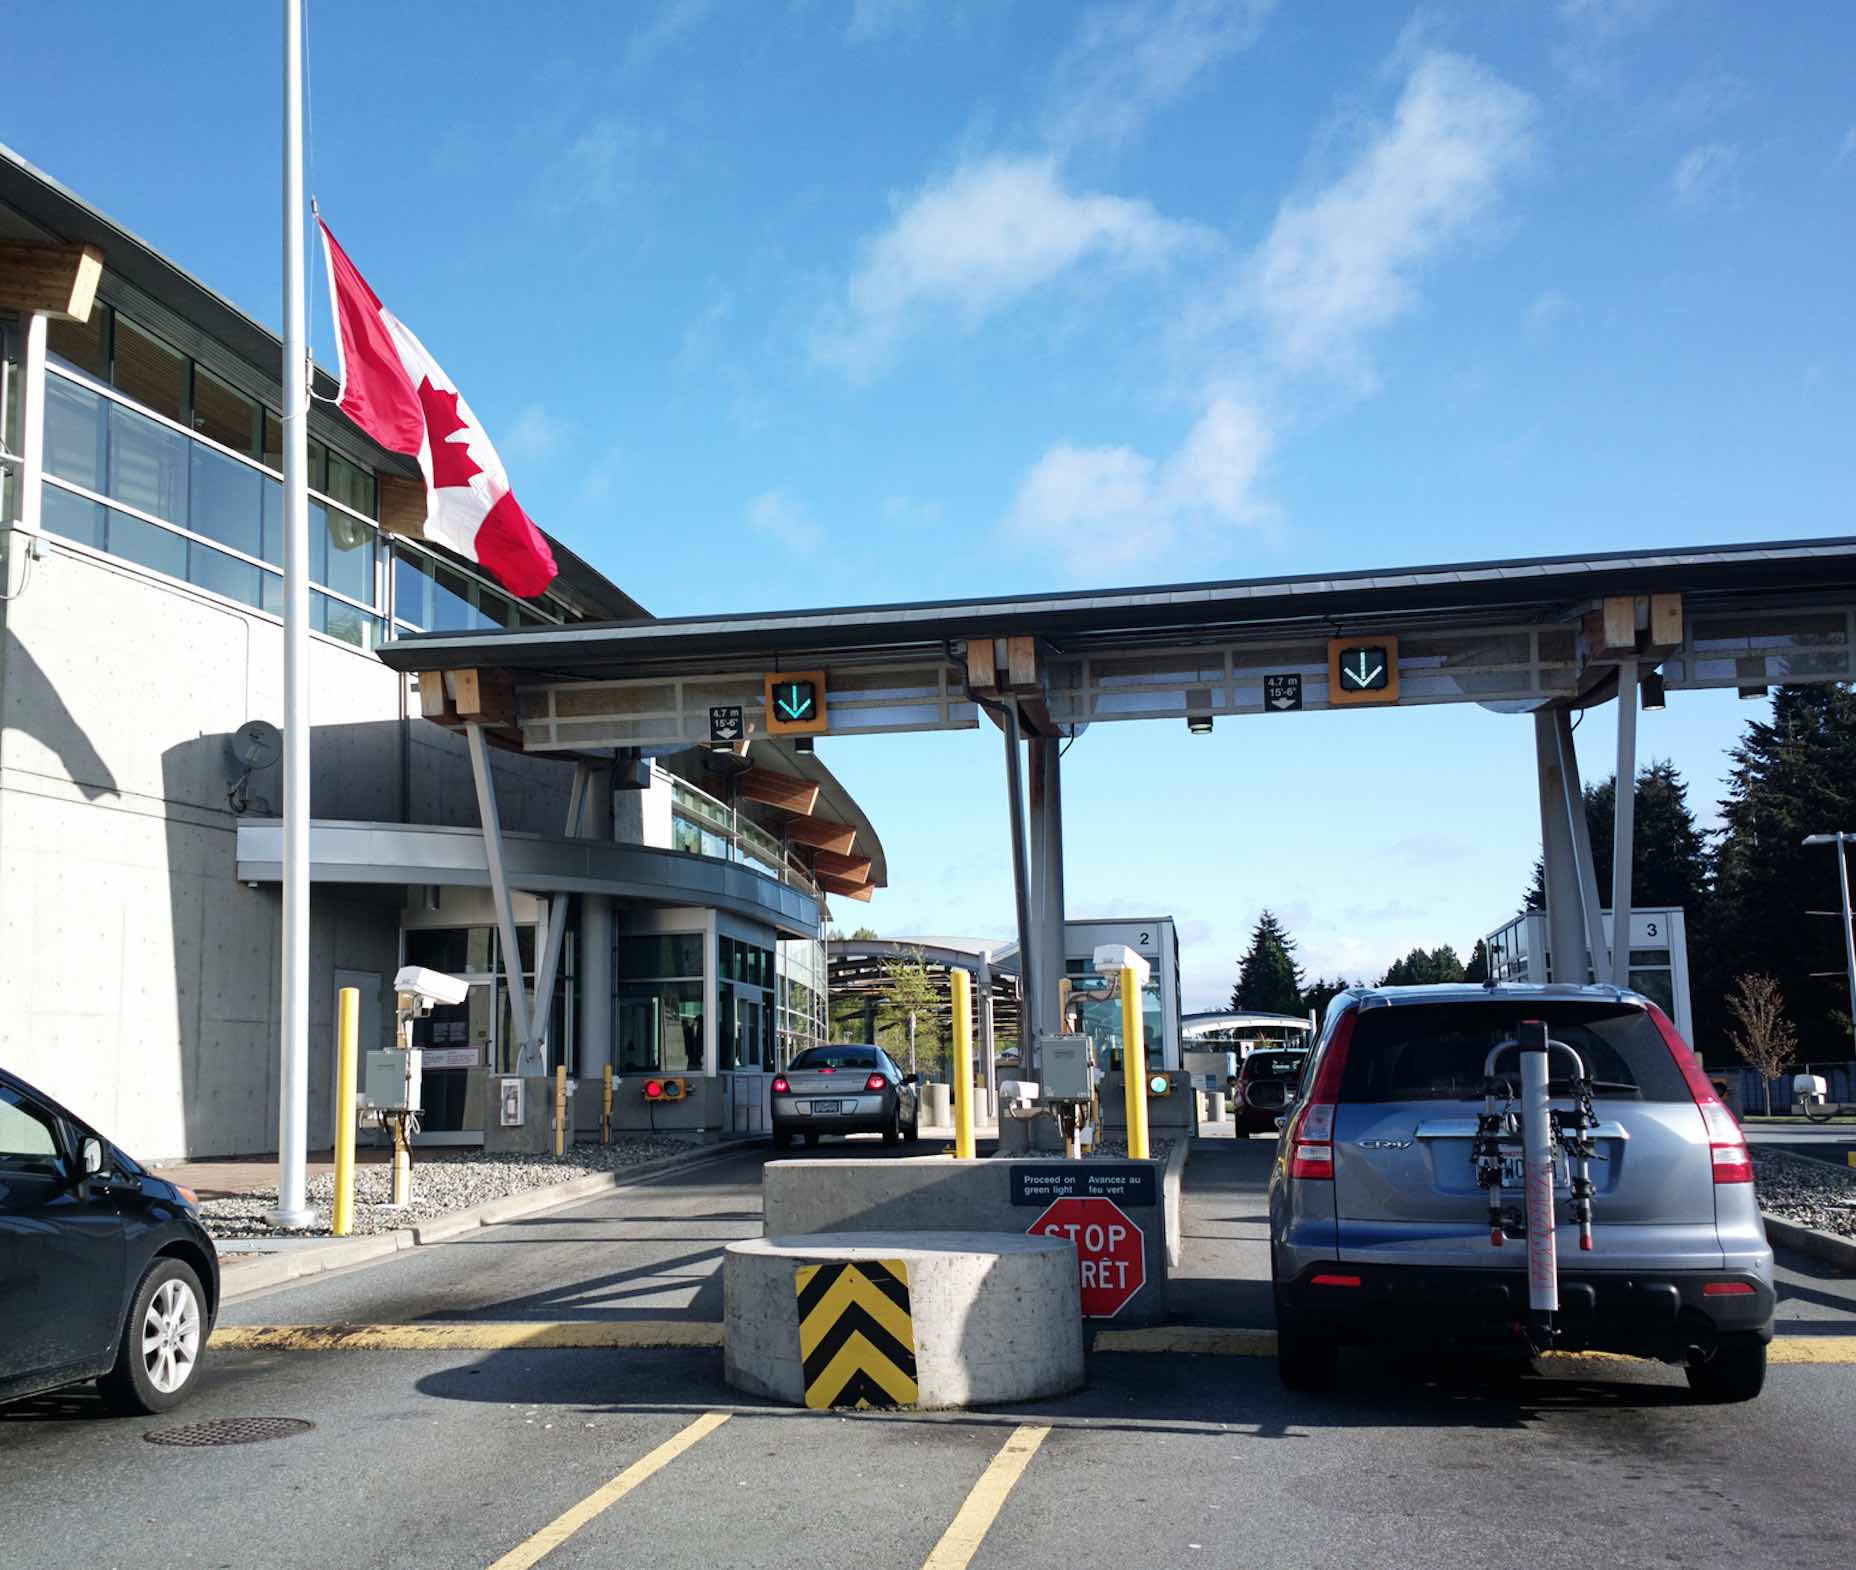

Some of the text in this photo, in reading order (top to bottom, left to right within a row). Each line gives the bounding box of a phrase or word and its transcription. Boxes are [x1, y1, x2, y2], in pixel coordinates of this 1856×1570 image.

[1268, 678, 1283, 686] 4.7
[713, 709, 726, 717] 4.7
[1647, 923, 1657, 937] 3
[1140, 932, 1149, 945] 2
[1024, 1175, 1061, 1184] Proceed
[1088, 1175, 1126, 1184] Avancez
[1024, 1186, 1073, 1195] green light
[1088, 1186, 1124, 1194] feu vert
